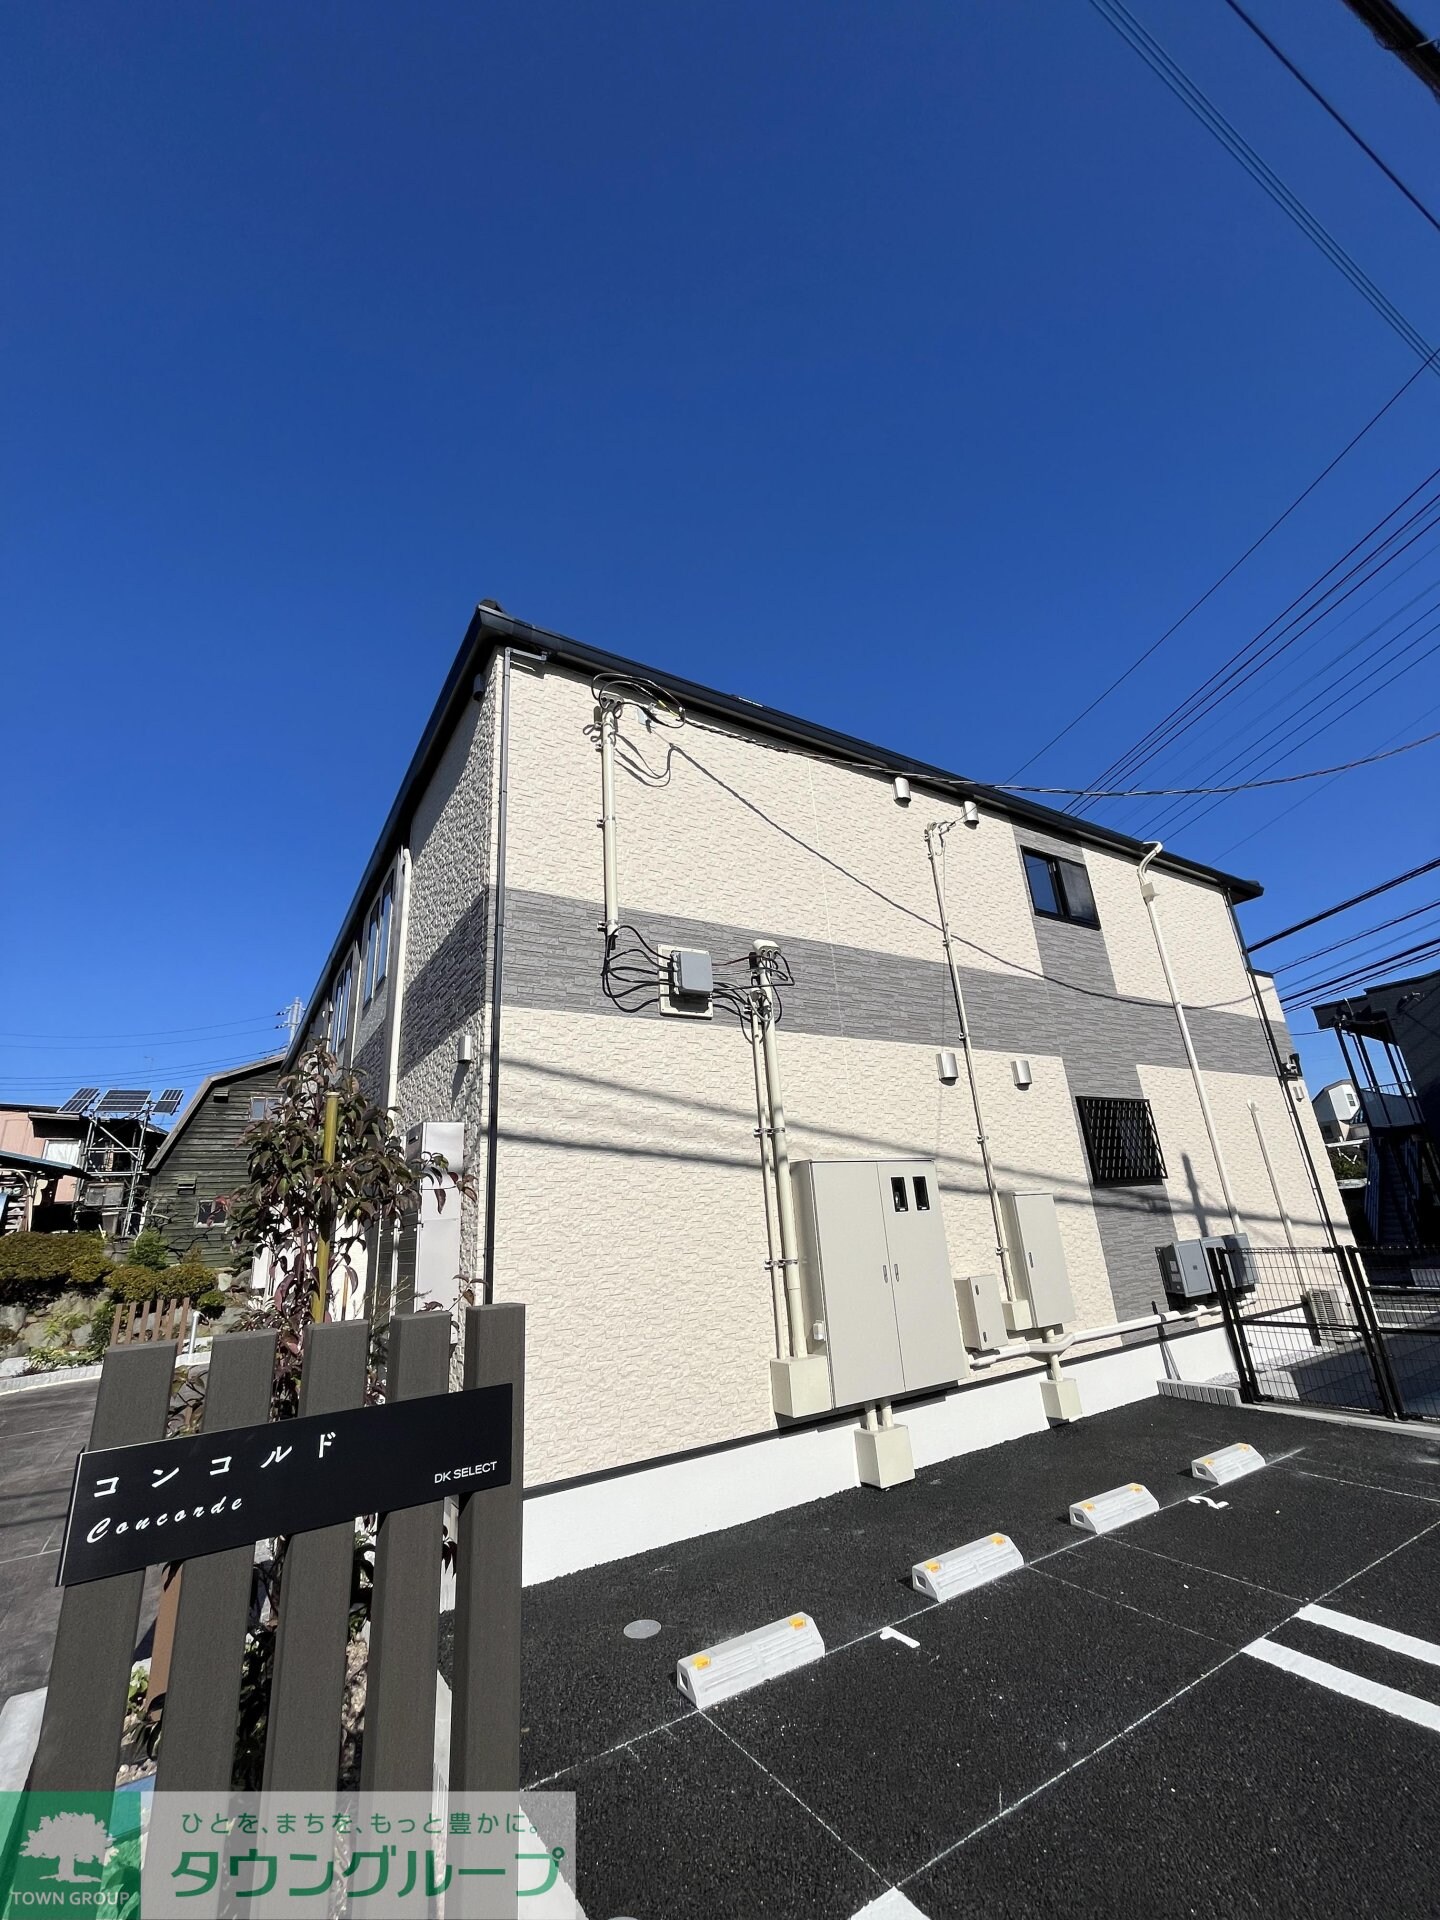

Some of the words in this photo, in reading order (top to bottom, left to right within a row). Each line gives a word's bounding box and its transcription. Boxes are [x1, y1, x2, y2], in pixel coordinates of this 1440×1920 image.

[93, 1431, 337, 1498] コンコルド
[434, 1470, 452, 1484] DK
[453, 1460, 498, 1480] SELECT
[86, 1496, 243, 1544] Concorde
